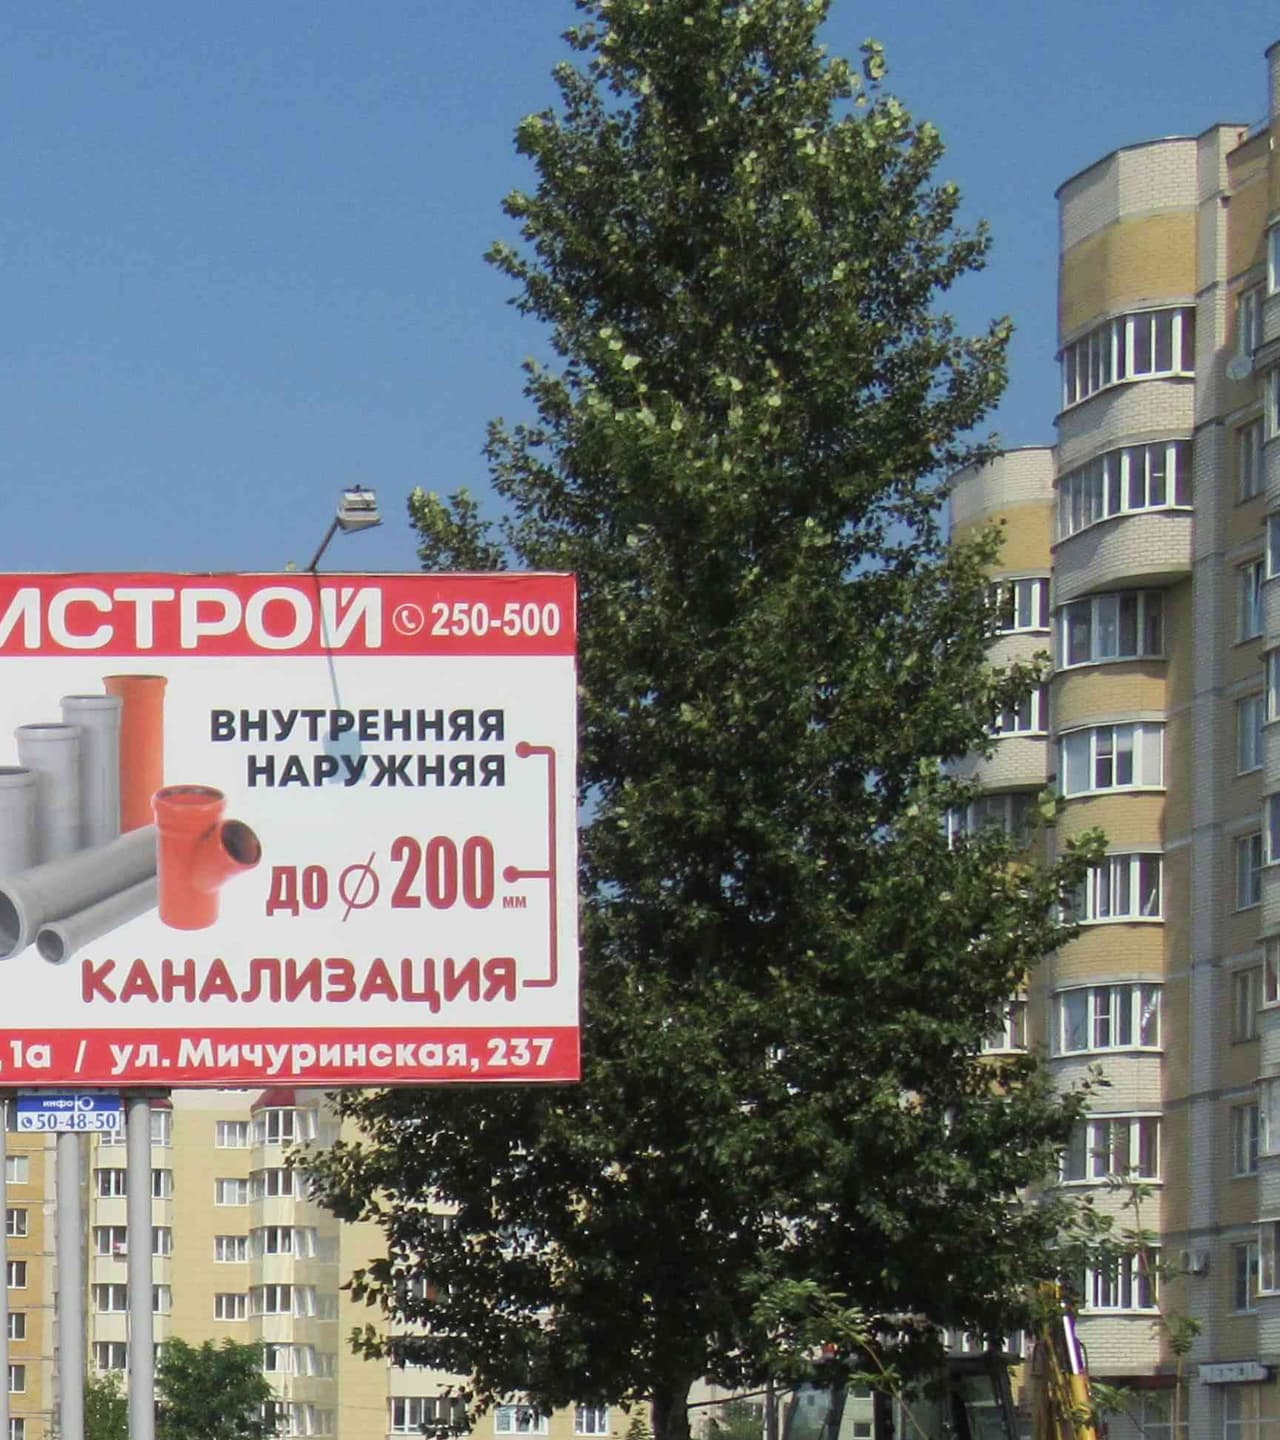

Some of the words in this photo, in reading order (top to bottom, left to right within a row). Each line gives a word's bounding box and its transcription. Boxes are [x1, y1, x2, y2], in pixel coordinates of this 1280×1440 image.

[431, 602, 560, 637] 250-500
[210, 708, 505, 742] ВНУТРЕННЯЯ
[246, 754, 506, 788] НАРУЖНЯЯ
[390, 835, 496, 910] 200
[81, 957, 517, 1014] КАНАЛИЗАЦИЯ
[8, 1039, 51, 1069] 1а
[109, 1042, 171, 1075] ул.
[178, 1038, 480, 1075] Мичуринская,
[486, 1037, 554, 1067] 237
[36, 1113, 116, 1129] 50-48-50
